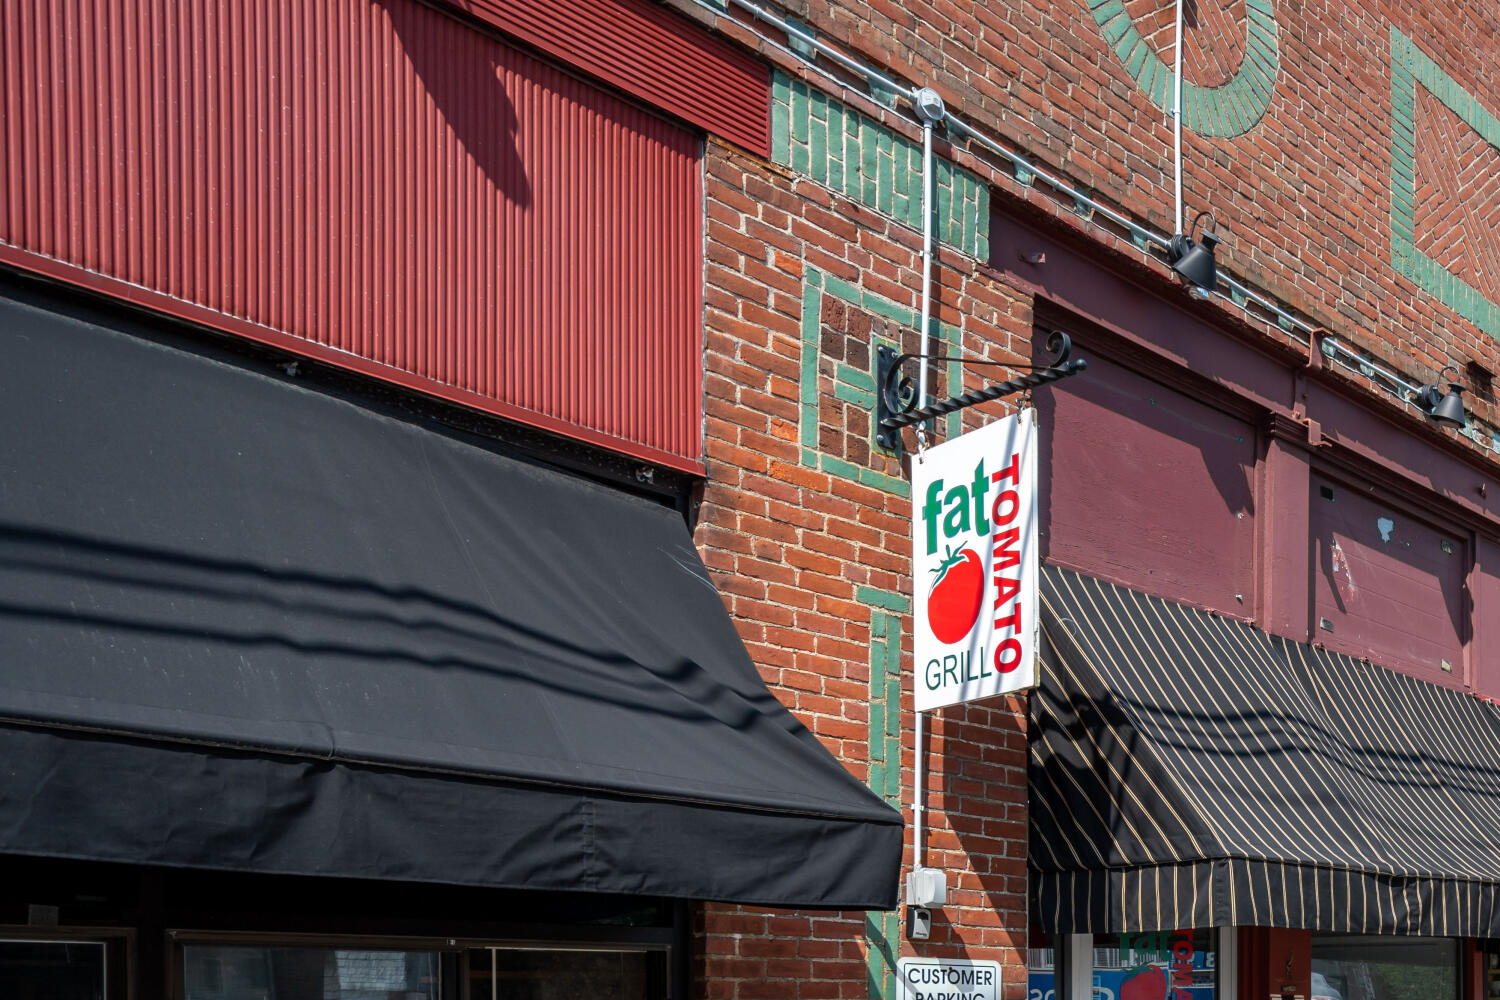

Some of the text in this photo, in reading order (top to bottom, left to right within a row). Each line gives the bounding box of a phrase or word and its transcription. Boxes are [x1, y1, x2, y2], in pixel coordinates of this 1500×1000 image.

[922, 457, 990, 556] fat
[992, 453, 1022, 674] TOMATO
[925, 646, 992, 691] GRILL
[908, 968, 993, 986] CUSTOMER
